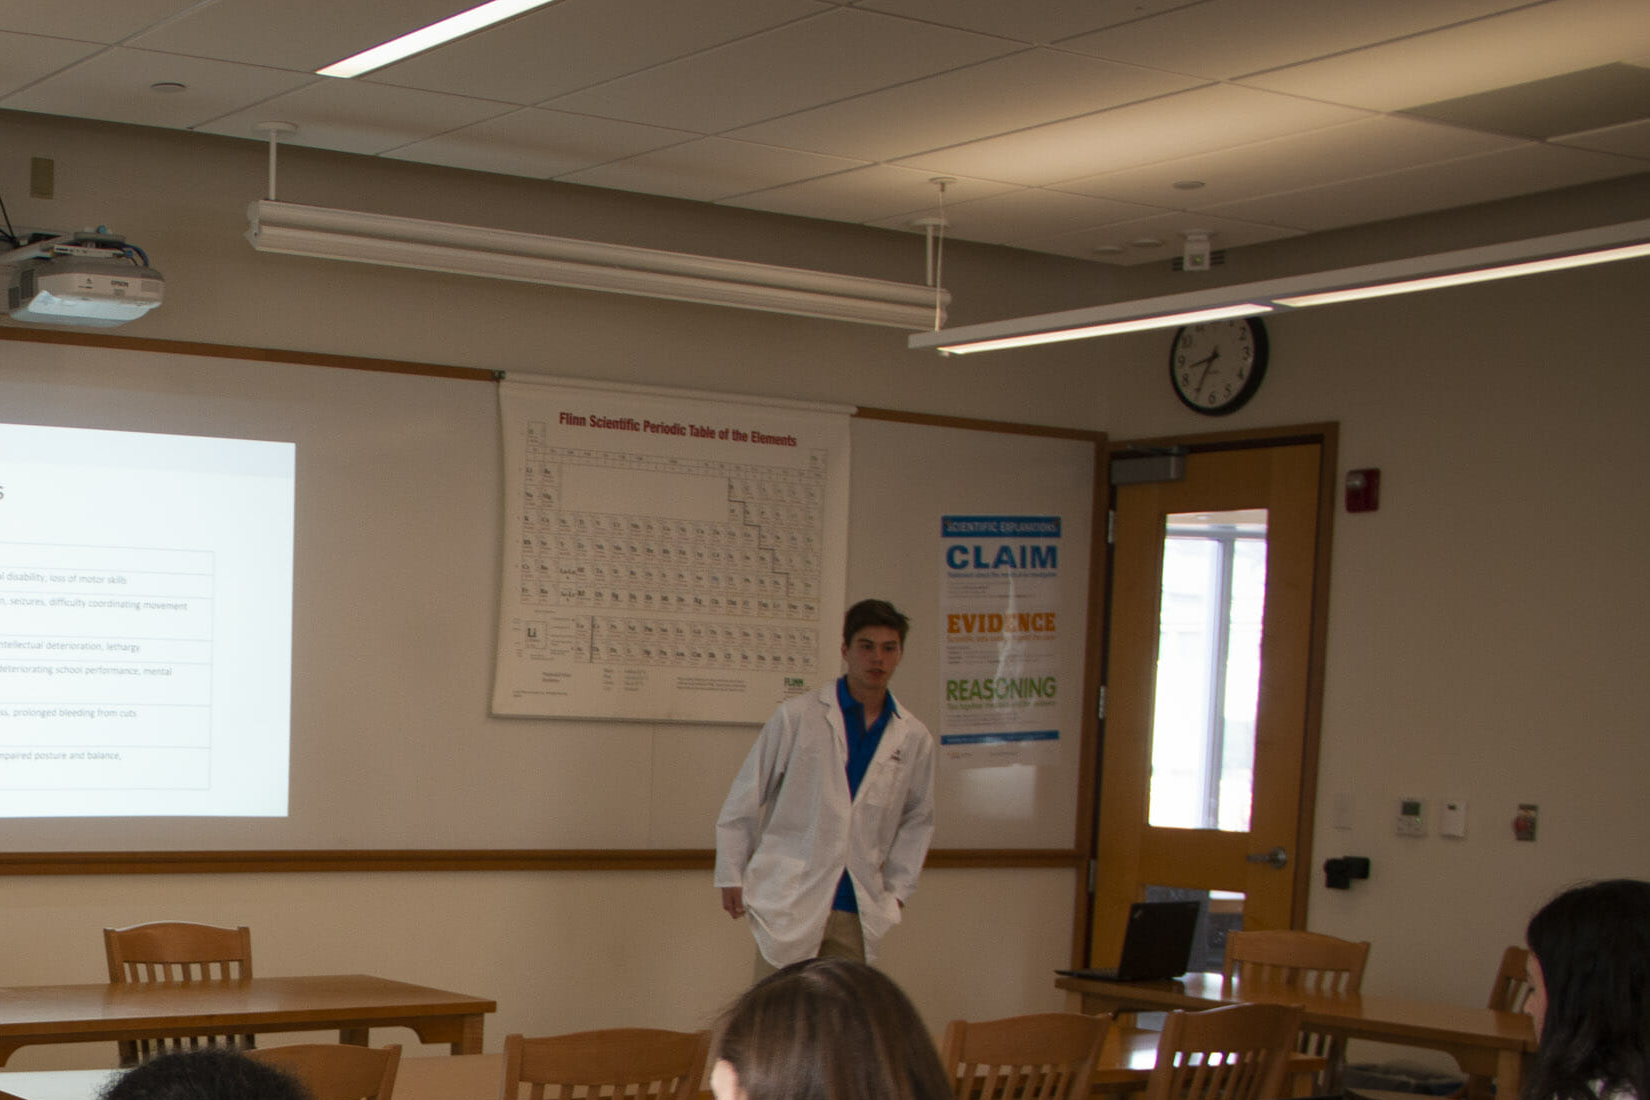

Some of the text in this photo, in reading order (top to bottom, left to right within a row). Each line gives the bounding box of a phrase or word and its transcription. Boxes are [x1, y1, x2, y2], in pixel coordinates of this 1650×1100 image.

[559, 411, 798, 447] Flinn Scientific Periodic Table of the Elements
[946, 544, 1057, 570] CLAIM
[7, 572, 47, 584] disability,
[50, 574, 66, 583] loss
[68, 574, 77, 583] of
[79, 576, 105, 585] motor
[10, 598, 46, 608] seizures,
[49, 598, 86, 610] difficulty
[88, 600, 141, 611] coordinating
[143, 602, 187, 611] movement
[946, 612, 1056, 634] EVIDENCE
[46, 641, 104, 652] deterioration,
[55, 665, 83, 675] school
[85, 666, 142, 677] performance,
[144, 667, 172, 677] mental
[946, 676, 1057, 701] REASONING
[14, 708, 56, 720] prolonged
[59, 708, 95, 719] bleeding
[97, 708, 118, 718] from
[120, 709, 136, 718] cuts
[34, 751, 67, 762] posture
[69, 751, 85, 761] and
